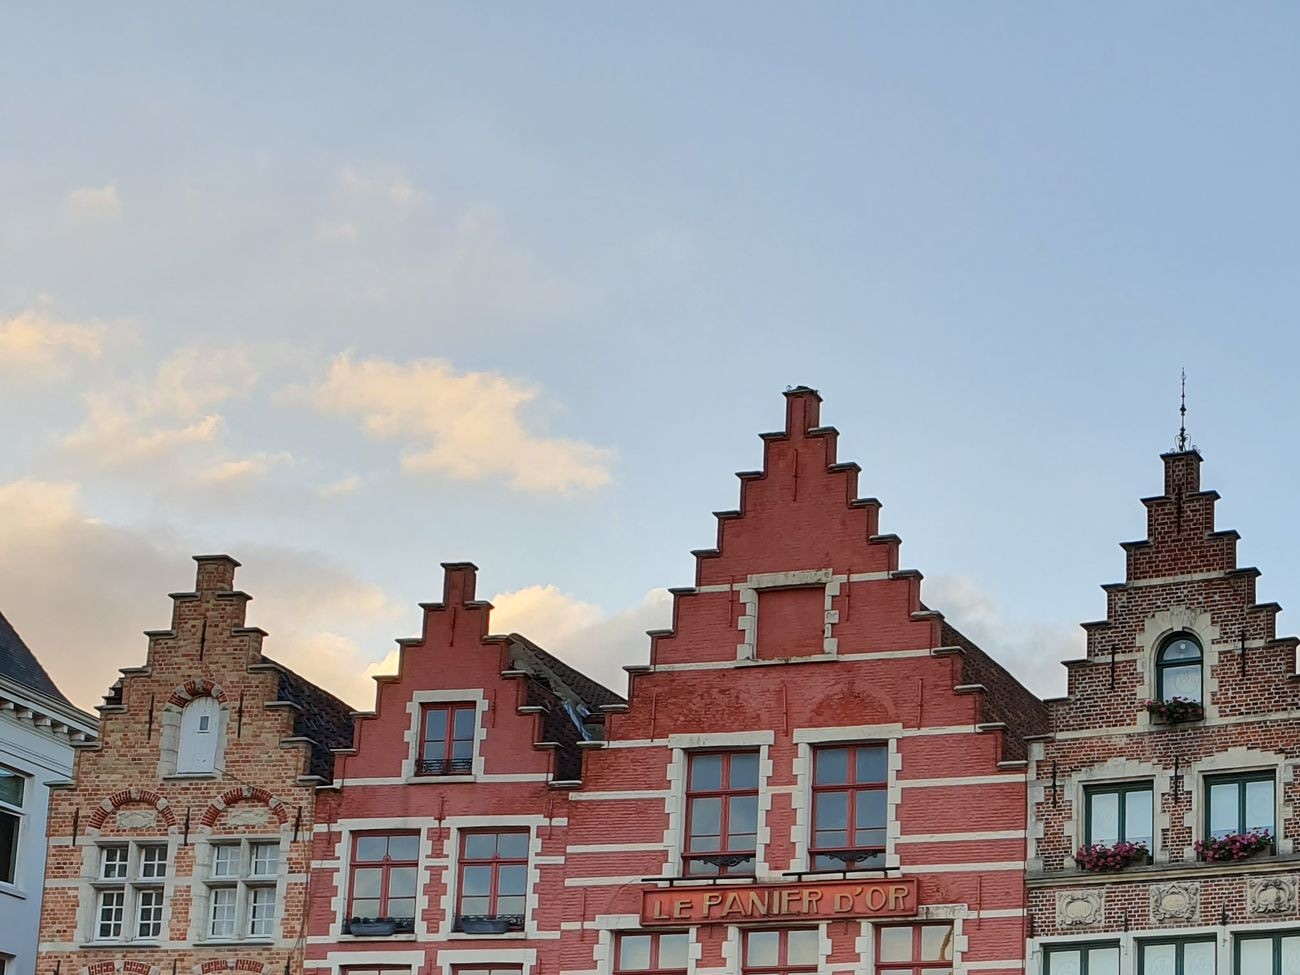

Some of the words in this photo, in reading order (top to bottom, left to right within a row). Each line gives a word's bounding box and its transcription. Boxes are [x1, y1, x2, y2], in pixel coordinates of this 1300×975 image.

[653, 899, 693, 919] LE
[702, 887, 824, 919] PANIER
[833, 885, 910, 914] D'OR
